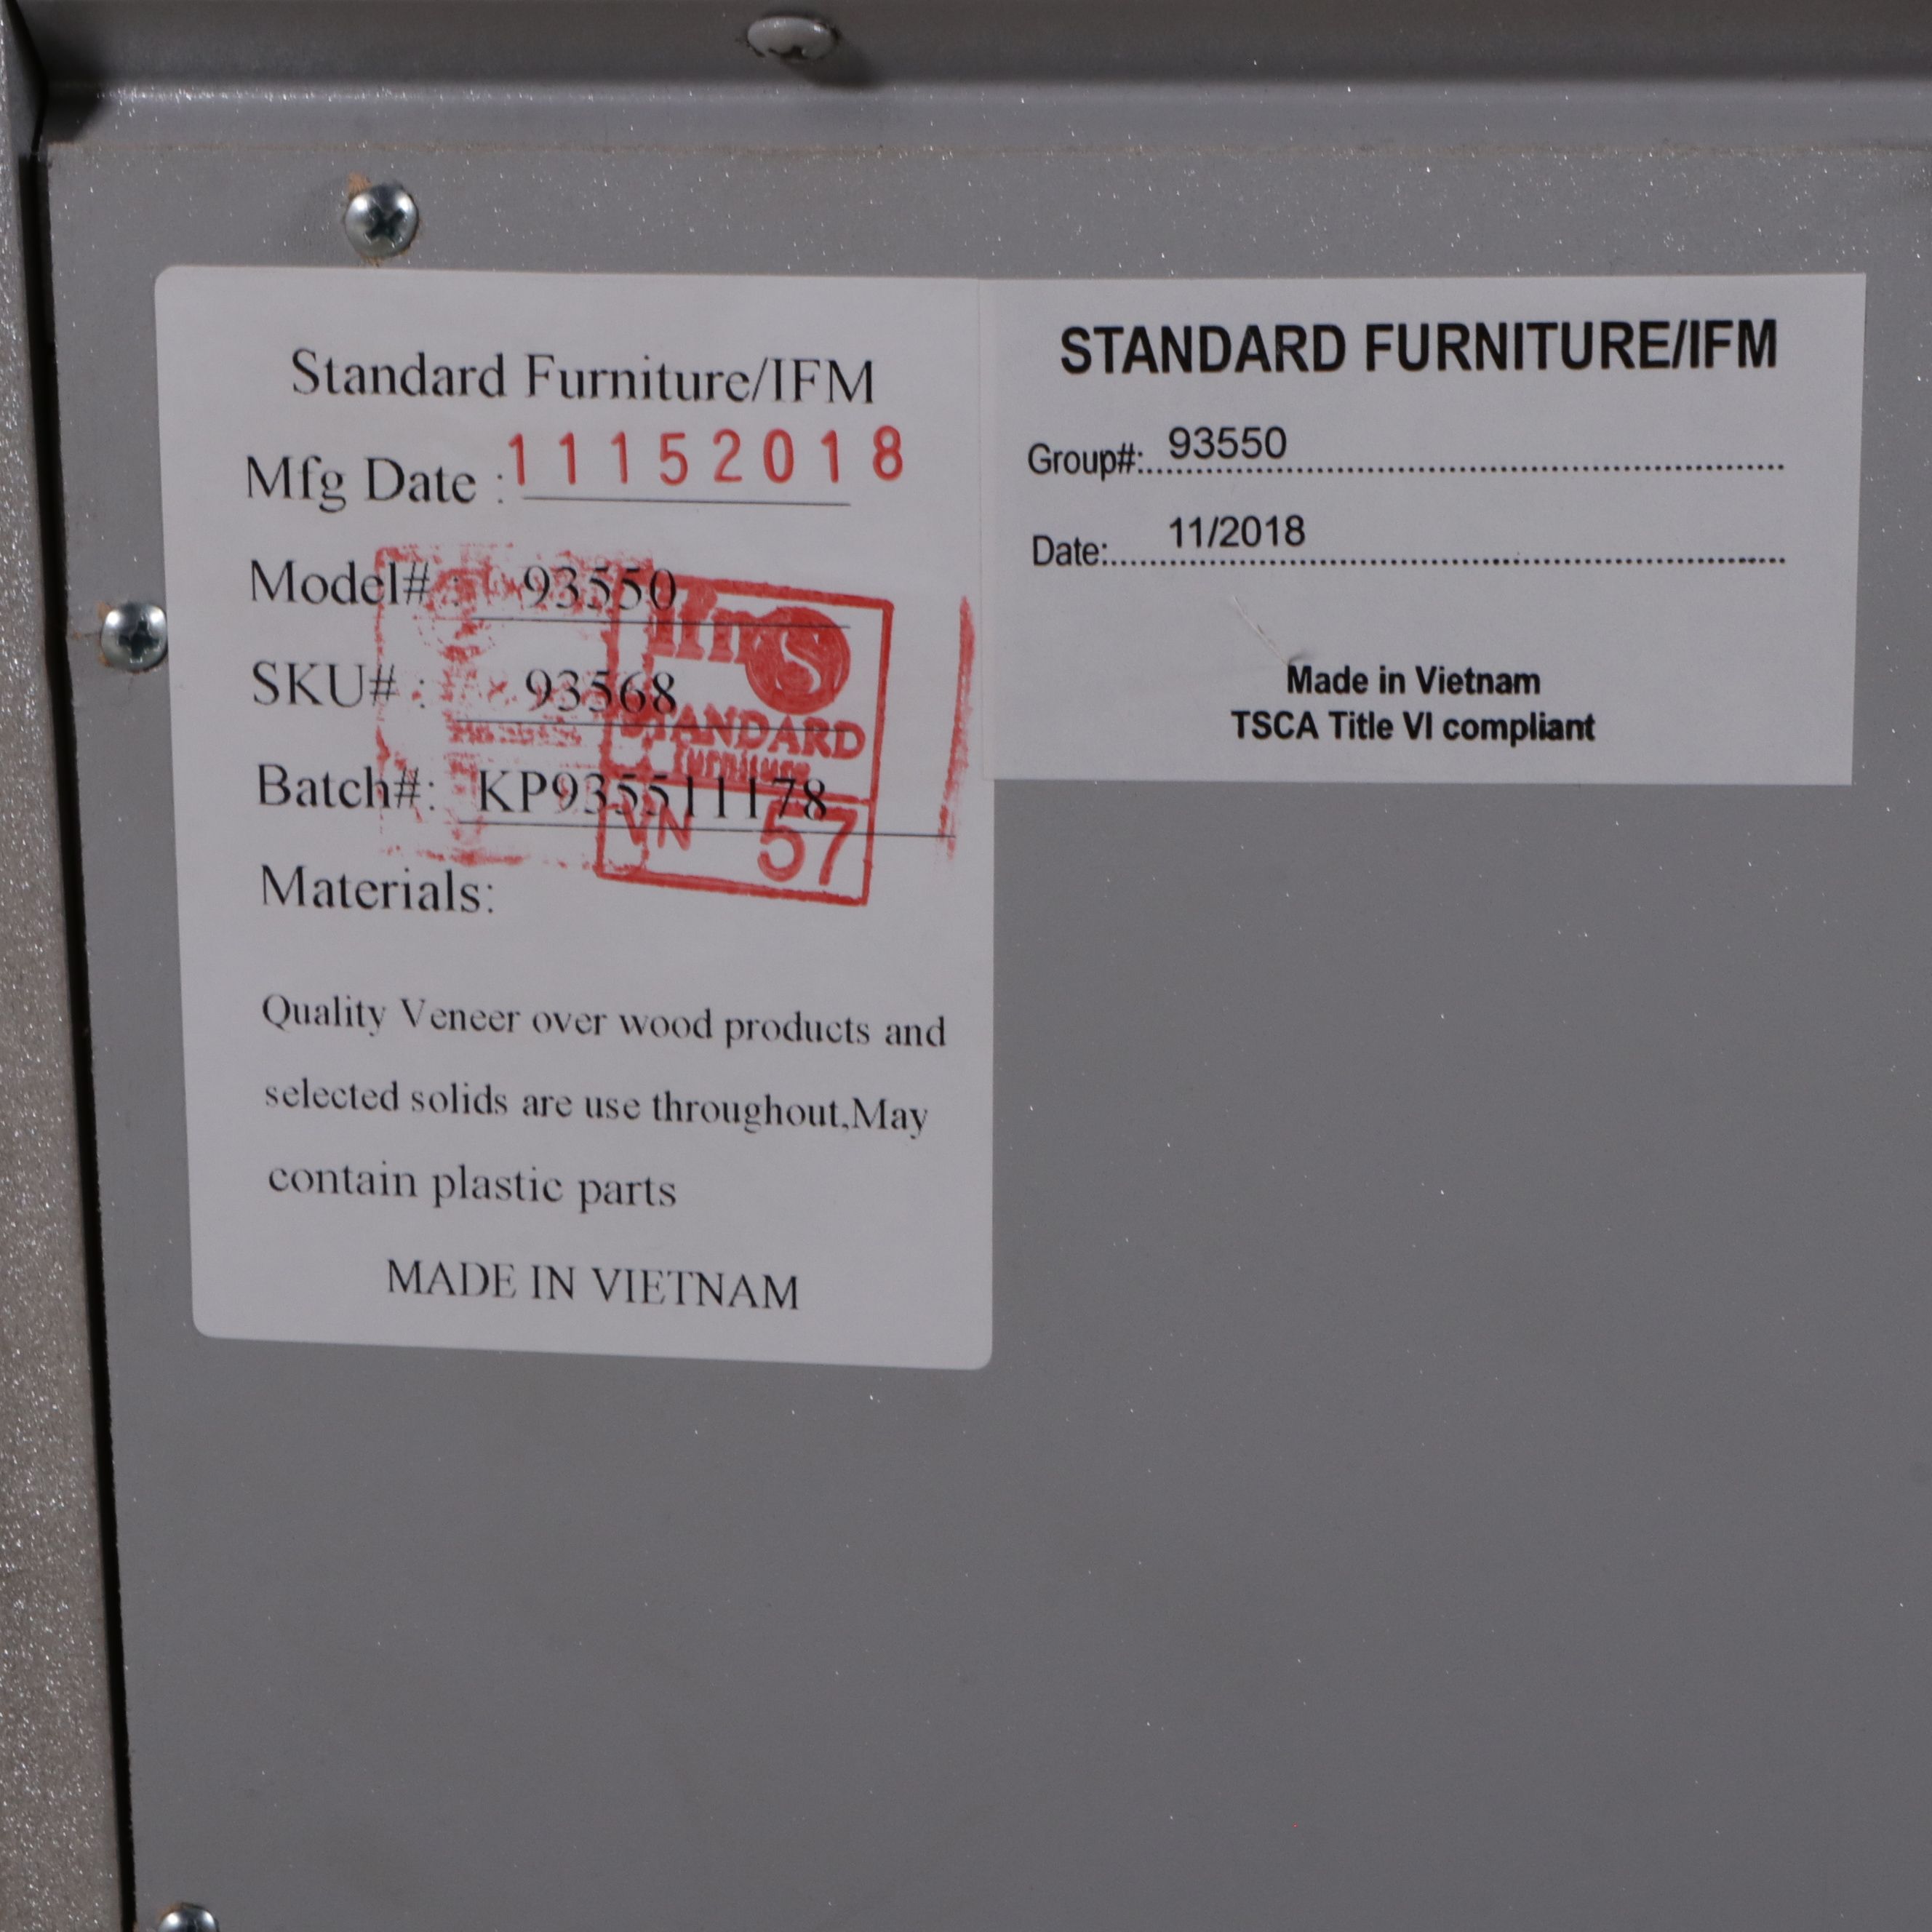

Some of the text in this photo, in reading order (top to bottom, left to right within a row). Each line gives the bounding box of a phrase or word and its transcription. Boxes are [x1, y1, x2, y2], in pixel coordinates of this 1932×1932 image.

[1061, 318, 1777, 375] STANDARD FURNITURE/IFM
[292, 348, 874, 404] Standard Furniture/IFM
[247, 455, 346, 514] Mfg
[367, 458, 476, 504] Date
[508, 425, 903, 487] 11152018
[1168, 426, 1287, 460] 93550
[1169, 514, 1306, 548] 11/2018
[251, 559, 430, 606] Model#
[523, 566, 677, 610] 93550
[252, 660, 396, 708] SKU#
[525, 669, 676, 714] 93568
[1287, 663, 1541, 695] Made in Vietnam
[619, 701, 866, 760] STANDARD
[1231, 710, 1596, 749] TSCA Title VI compliant
[258, 764, 827, 820] Batch#: KP935511178
[757, 799, 859, 886] 57
[262, 864, 493, 913] Materials:
[262, 995, 946, 1049] Quality Veneer over wood products and
[266, 1077, 399, 1111] selected
[411, 1082, 508, 1115] solids
[522, 1095, 572, 1118] are
[586, 1097, 640, 1120] use
[268, 1160, 676, 1214] contain plastic parts
[388, 1259, 798, 1310] MADE IN VIETNAM
